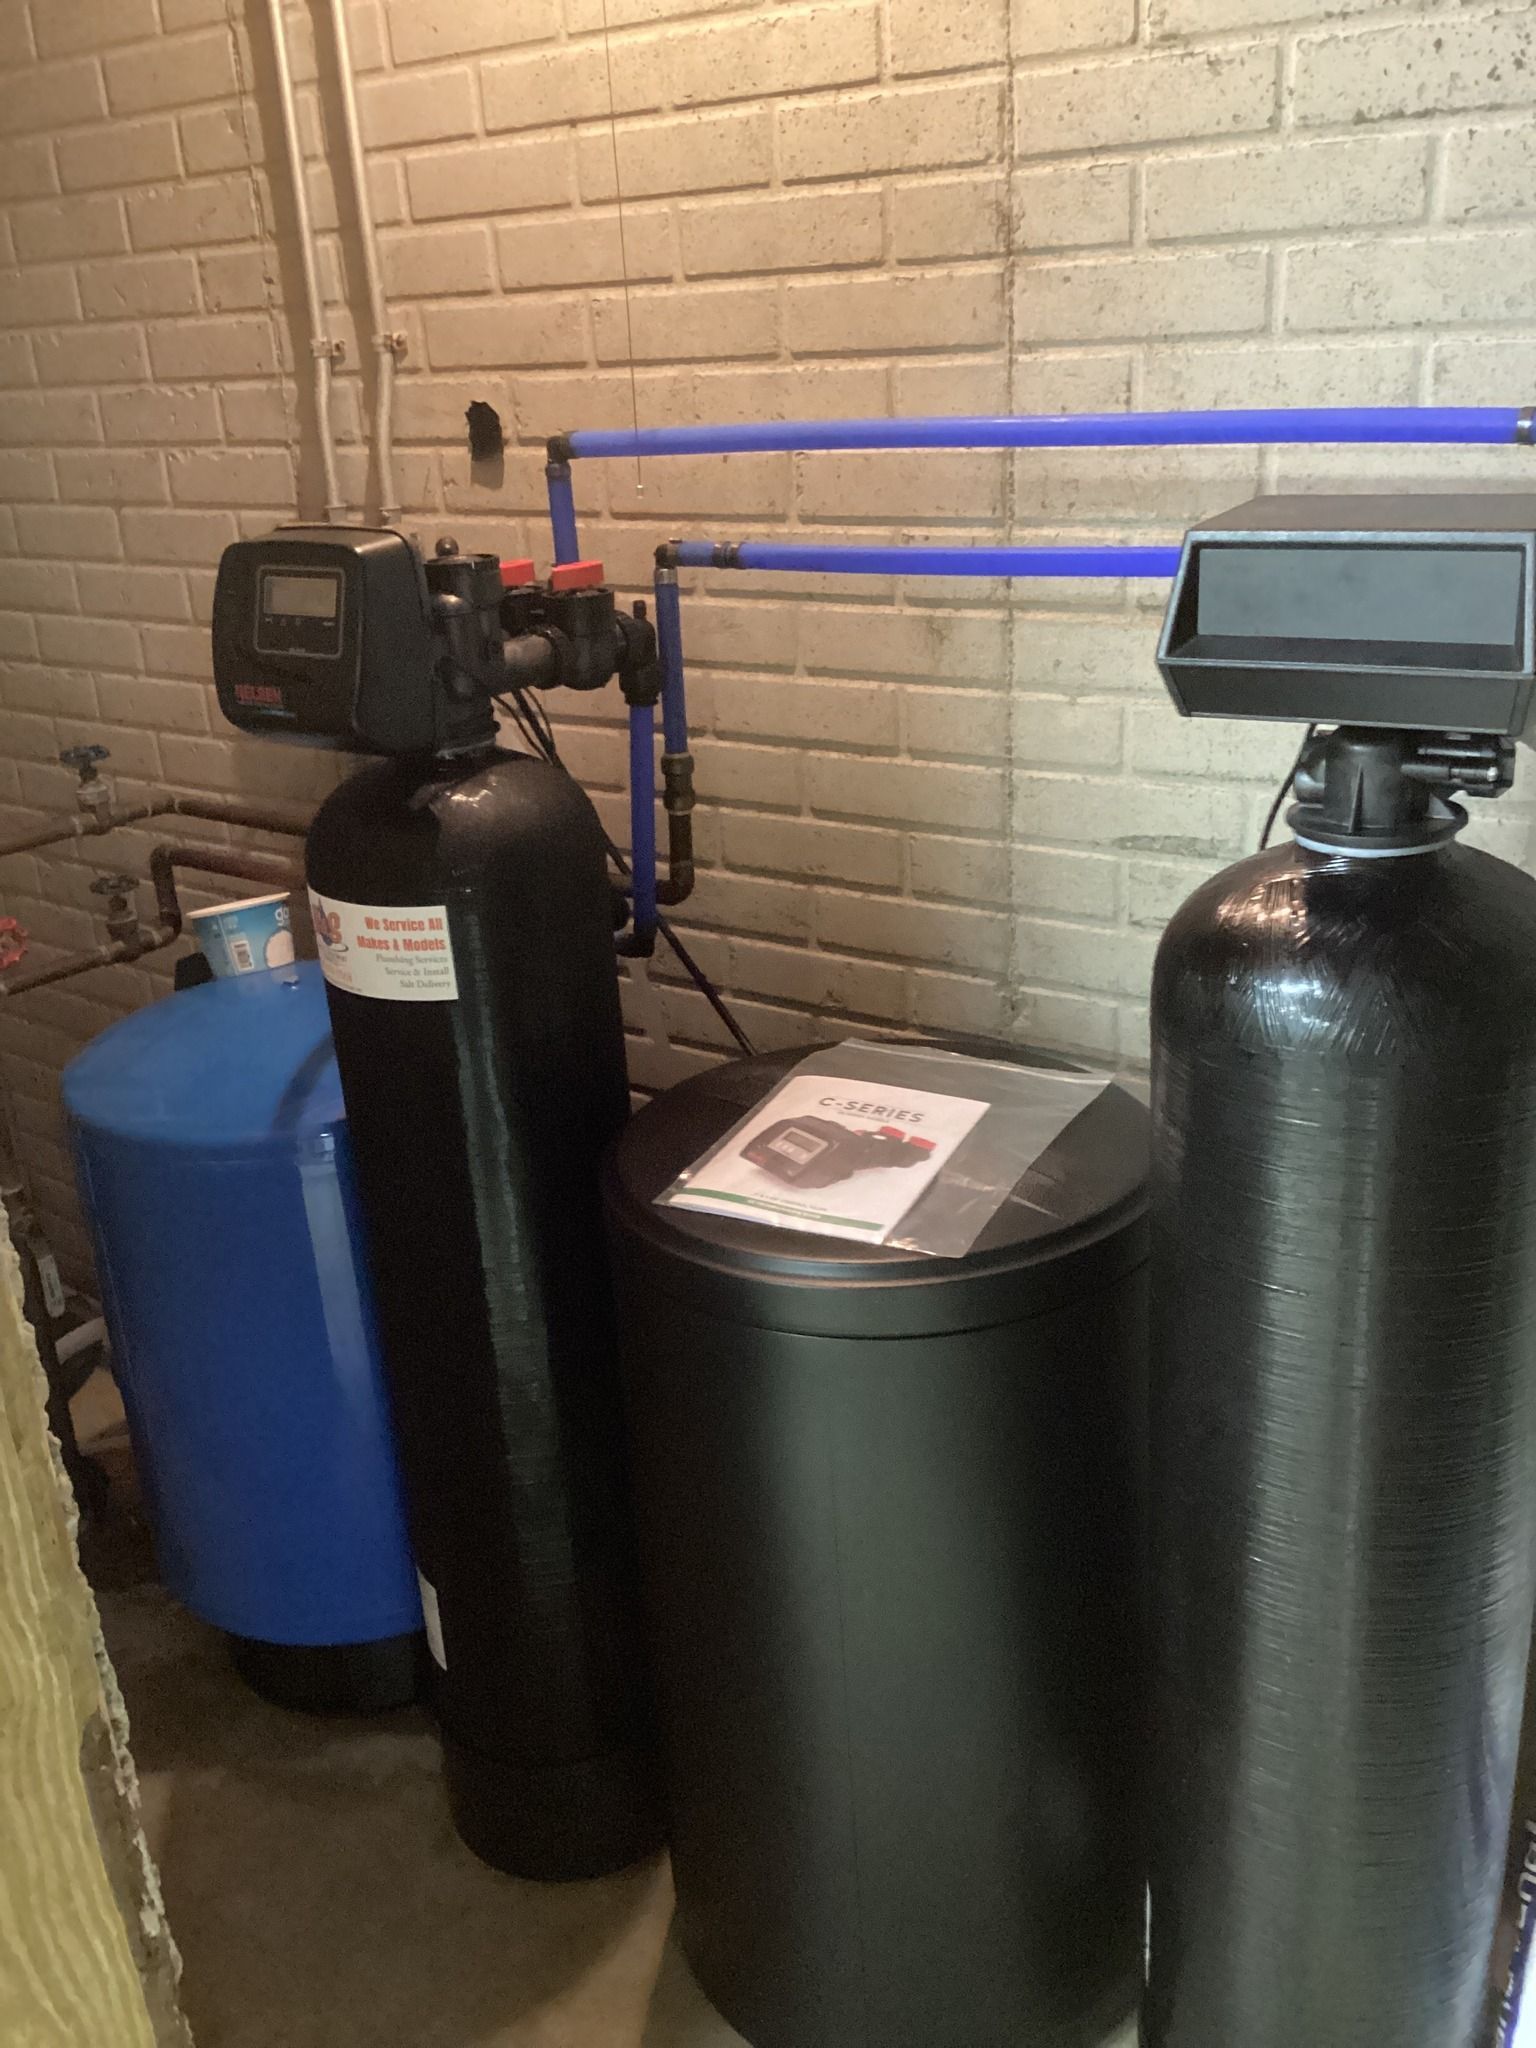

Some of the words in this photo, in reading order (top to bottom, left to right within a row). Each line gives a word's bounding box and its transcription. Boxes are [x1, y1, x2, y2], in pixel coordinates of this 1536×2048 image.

[364, 916, 380, 930] We
[382, 917, 425, 931] Service
[428, 917, 443, 930] All
[357, 935, 390, 951] Makes
[402, 937, 446, 952] Models
[818, 1096, 925, 1123] C-SERIES
